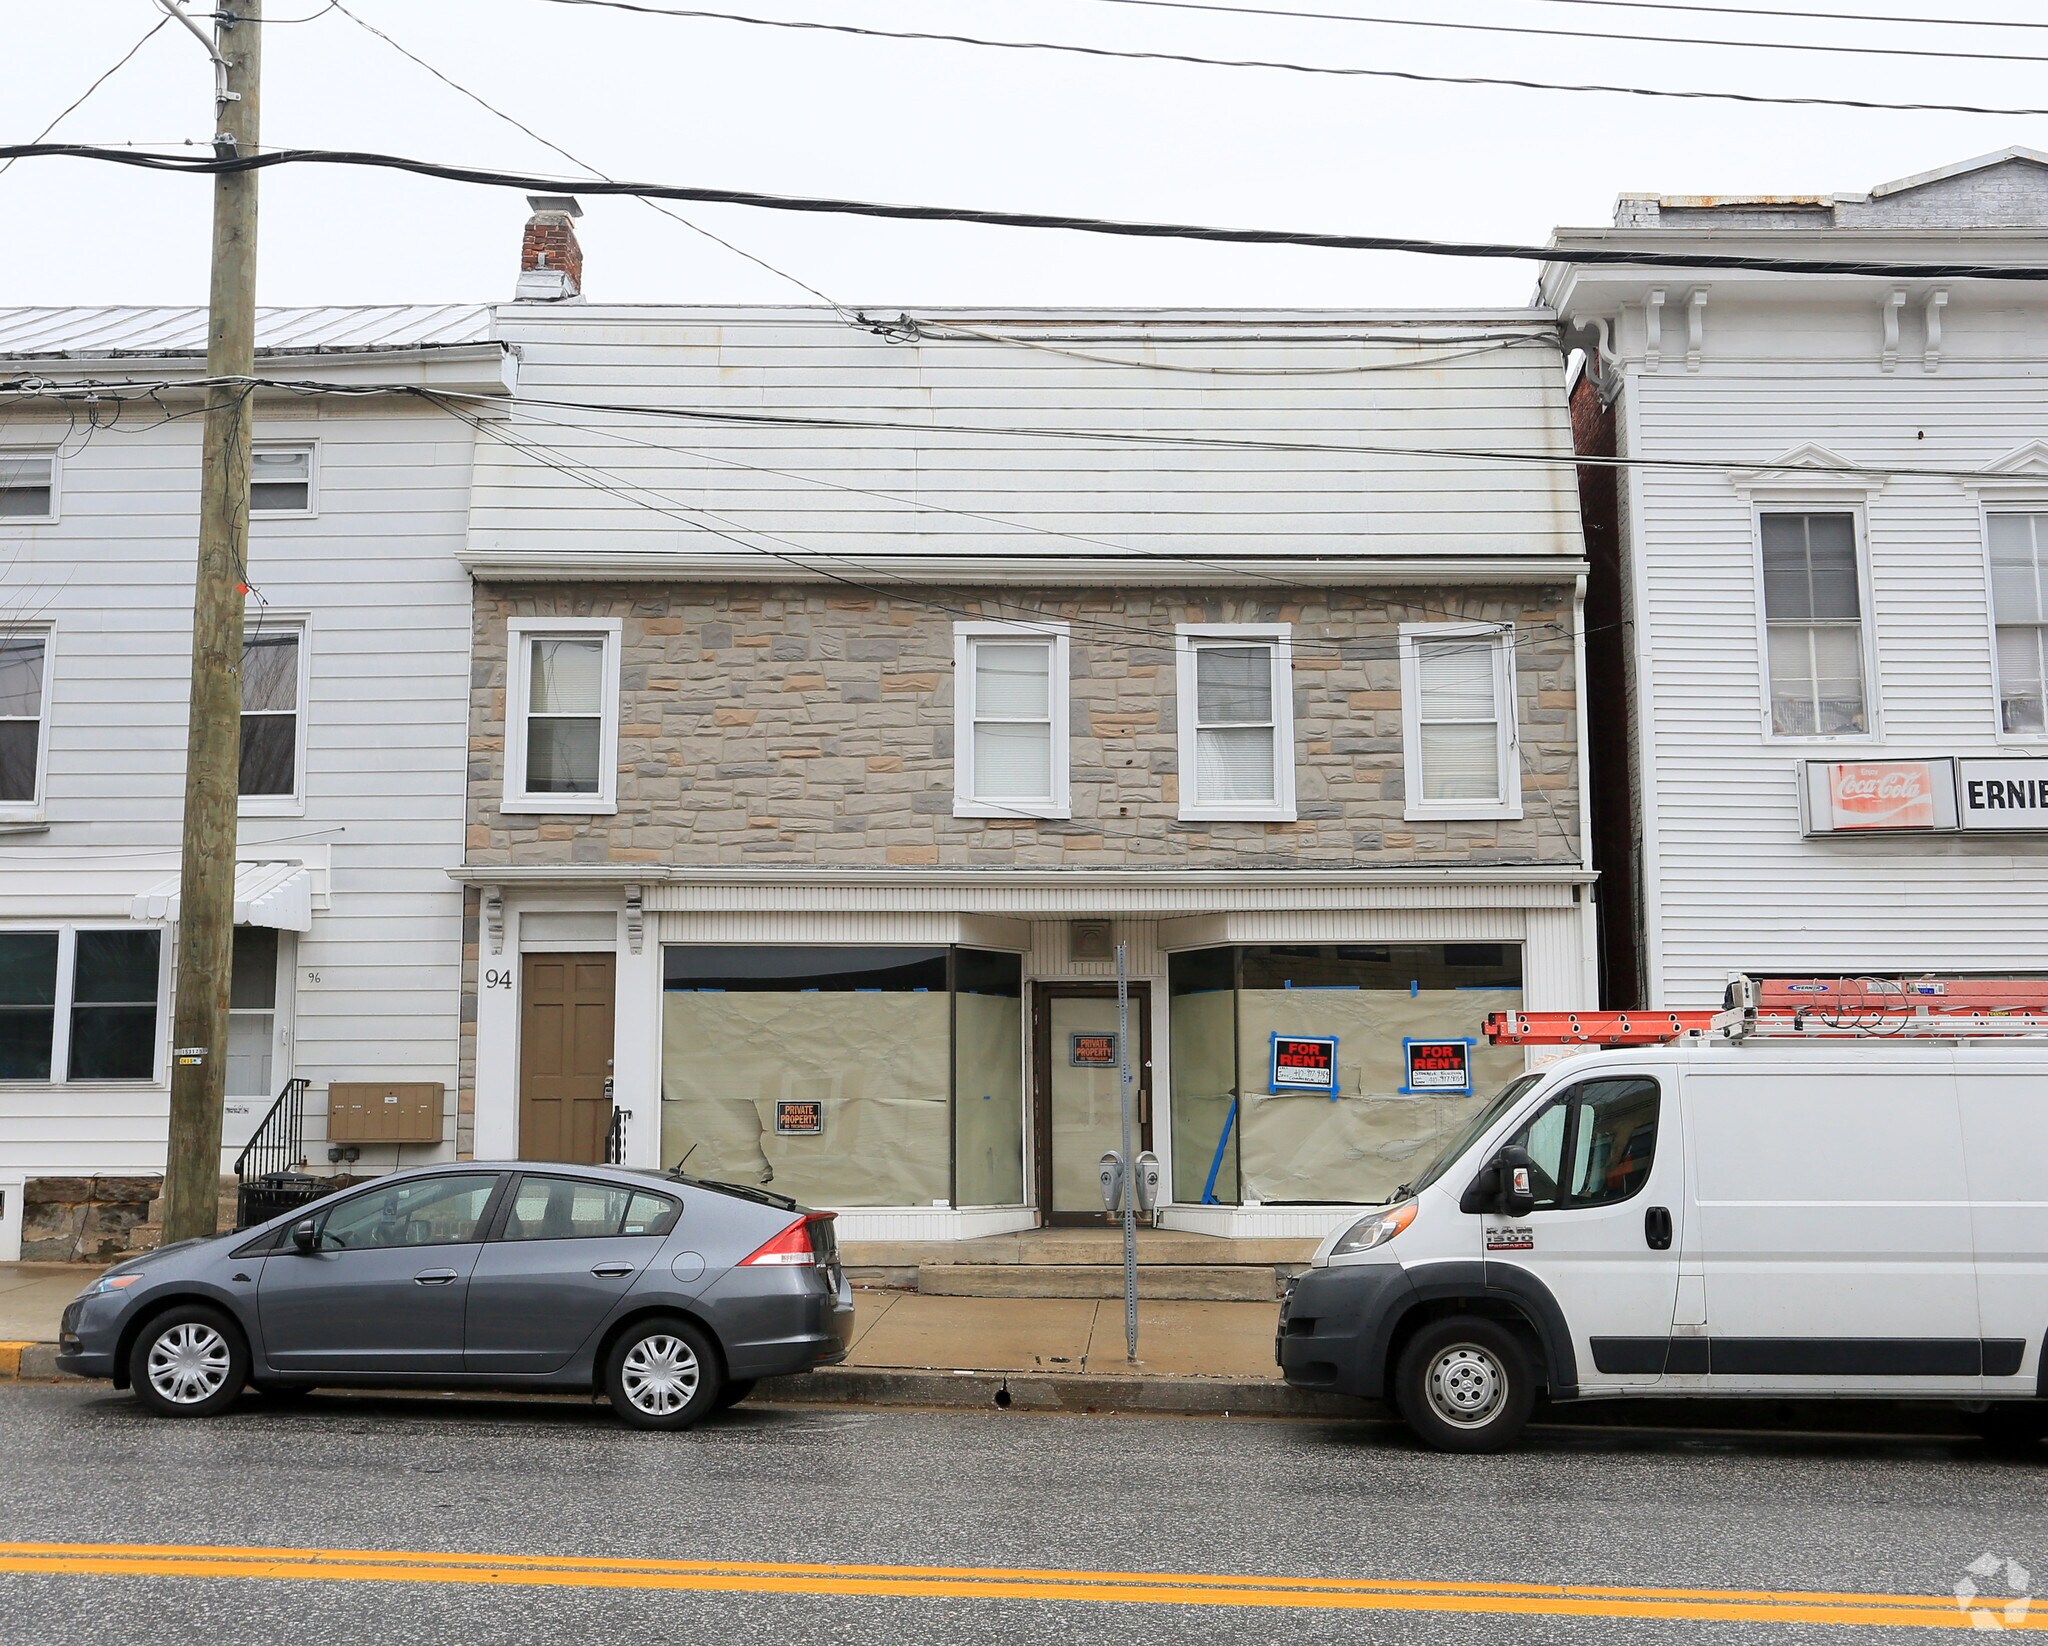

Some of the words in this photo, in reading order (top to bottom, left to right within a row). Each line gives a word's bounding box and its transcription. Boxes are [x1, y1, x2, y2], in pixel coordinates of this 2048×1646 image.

[1838, 772, 1921, 799] Coca-Cola
[308, 972, 321, 984] 96
[485, 968, 513, 990] 94
[1081, 1039, 1107, 1047] PRIVATE
[1076, 1047, 1112, 1056] PROPERTY
[1289, 1043, 1319, 1055] FOR
[1422, 1046, 1452, 1057] FOR
[1280, 1054, 1327, 1067] RENT
[1414, 1058, 1461, 1069] RENT
[785, 1105, 813, 1114] PRIVATE
[780, 1114, 817, 1124] PROPERTY
[1486, 1226, 1532, 1234] RAM
[1486, 1234, 1533, 1242] 1500
